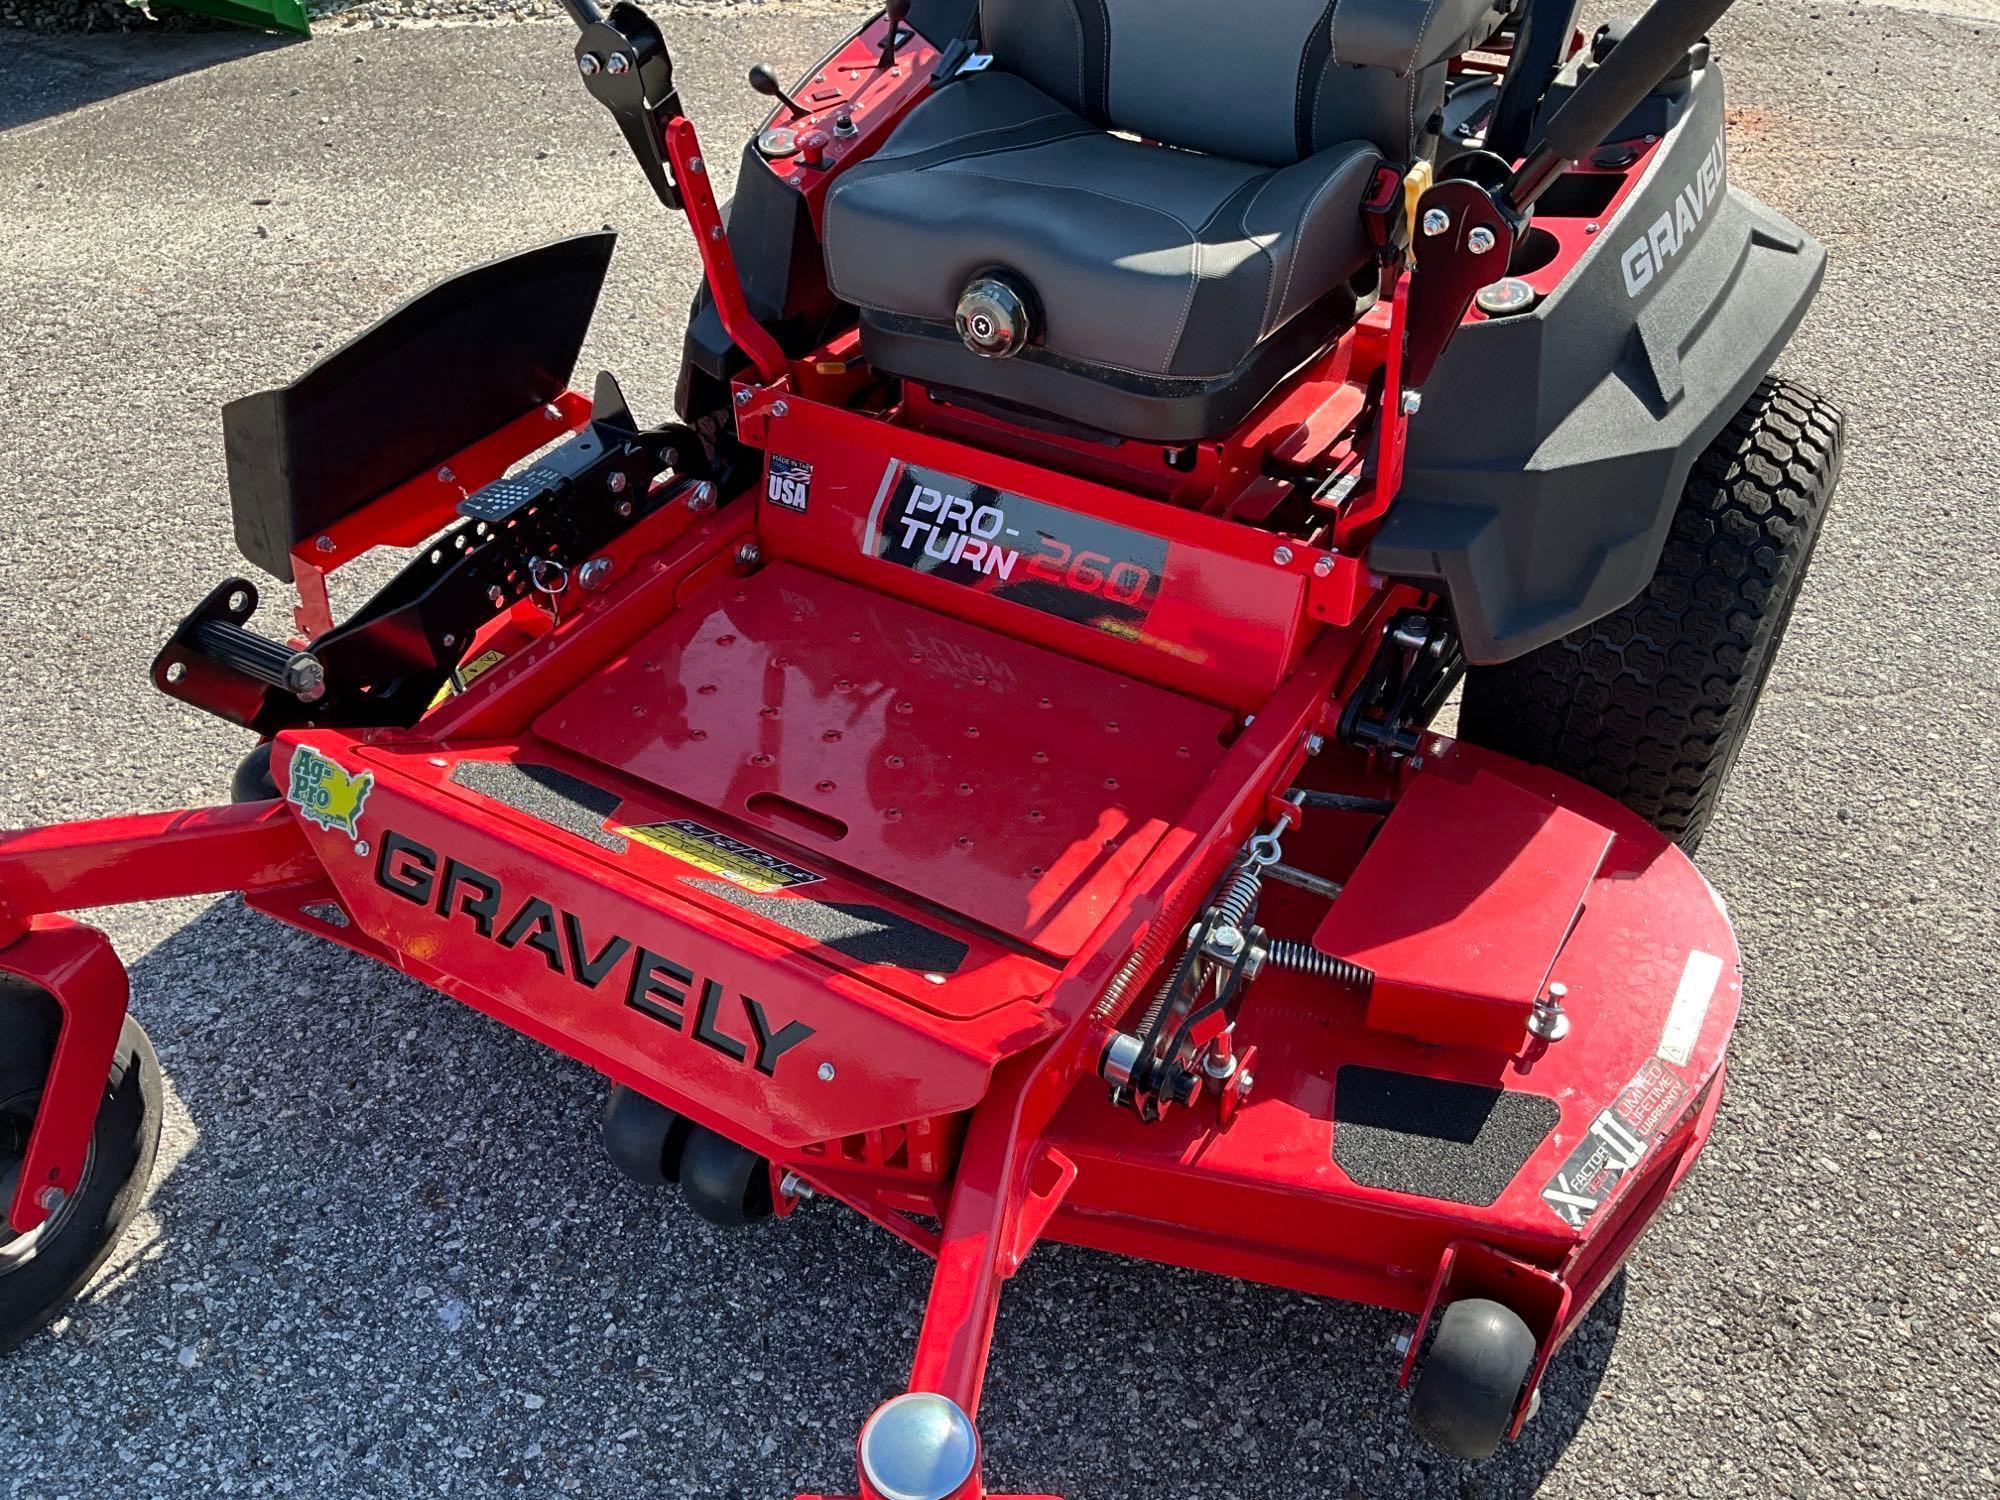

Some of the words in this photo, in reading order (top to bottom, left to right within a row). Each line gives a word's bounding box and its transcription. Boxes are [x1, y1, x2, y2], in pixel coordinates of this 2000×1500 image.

[1621, 123, 1725, 298] GRAVELY
[772, 455, 790, 465] MADE
[798, 462, 811, 471] THE
[769, 474, 806, 509] USA
[904, 484, 1020, 540] PRO-
[900, 516, 1019, 581] TURN
[1026, 536, 1150, 605] 260
[291, 774, 330, 807] Pro
[294, 750, 333, 785] Ag-
[374, 829, 816, 1078] GRAVELY
[1616, 1065, 1663, 1117] LIMITED
[1627, 1073, 1674, 1126] LIFETIME
[1638, 1080, 1683, 1136] WARRANTY
[1542, 1172, 1598, 1228] X
